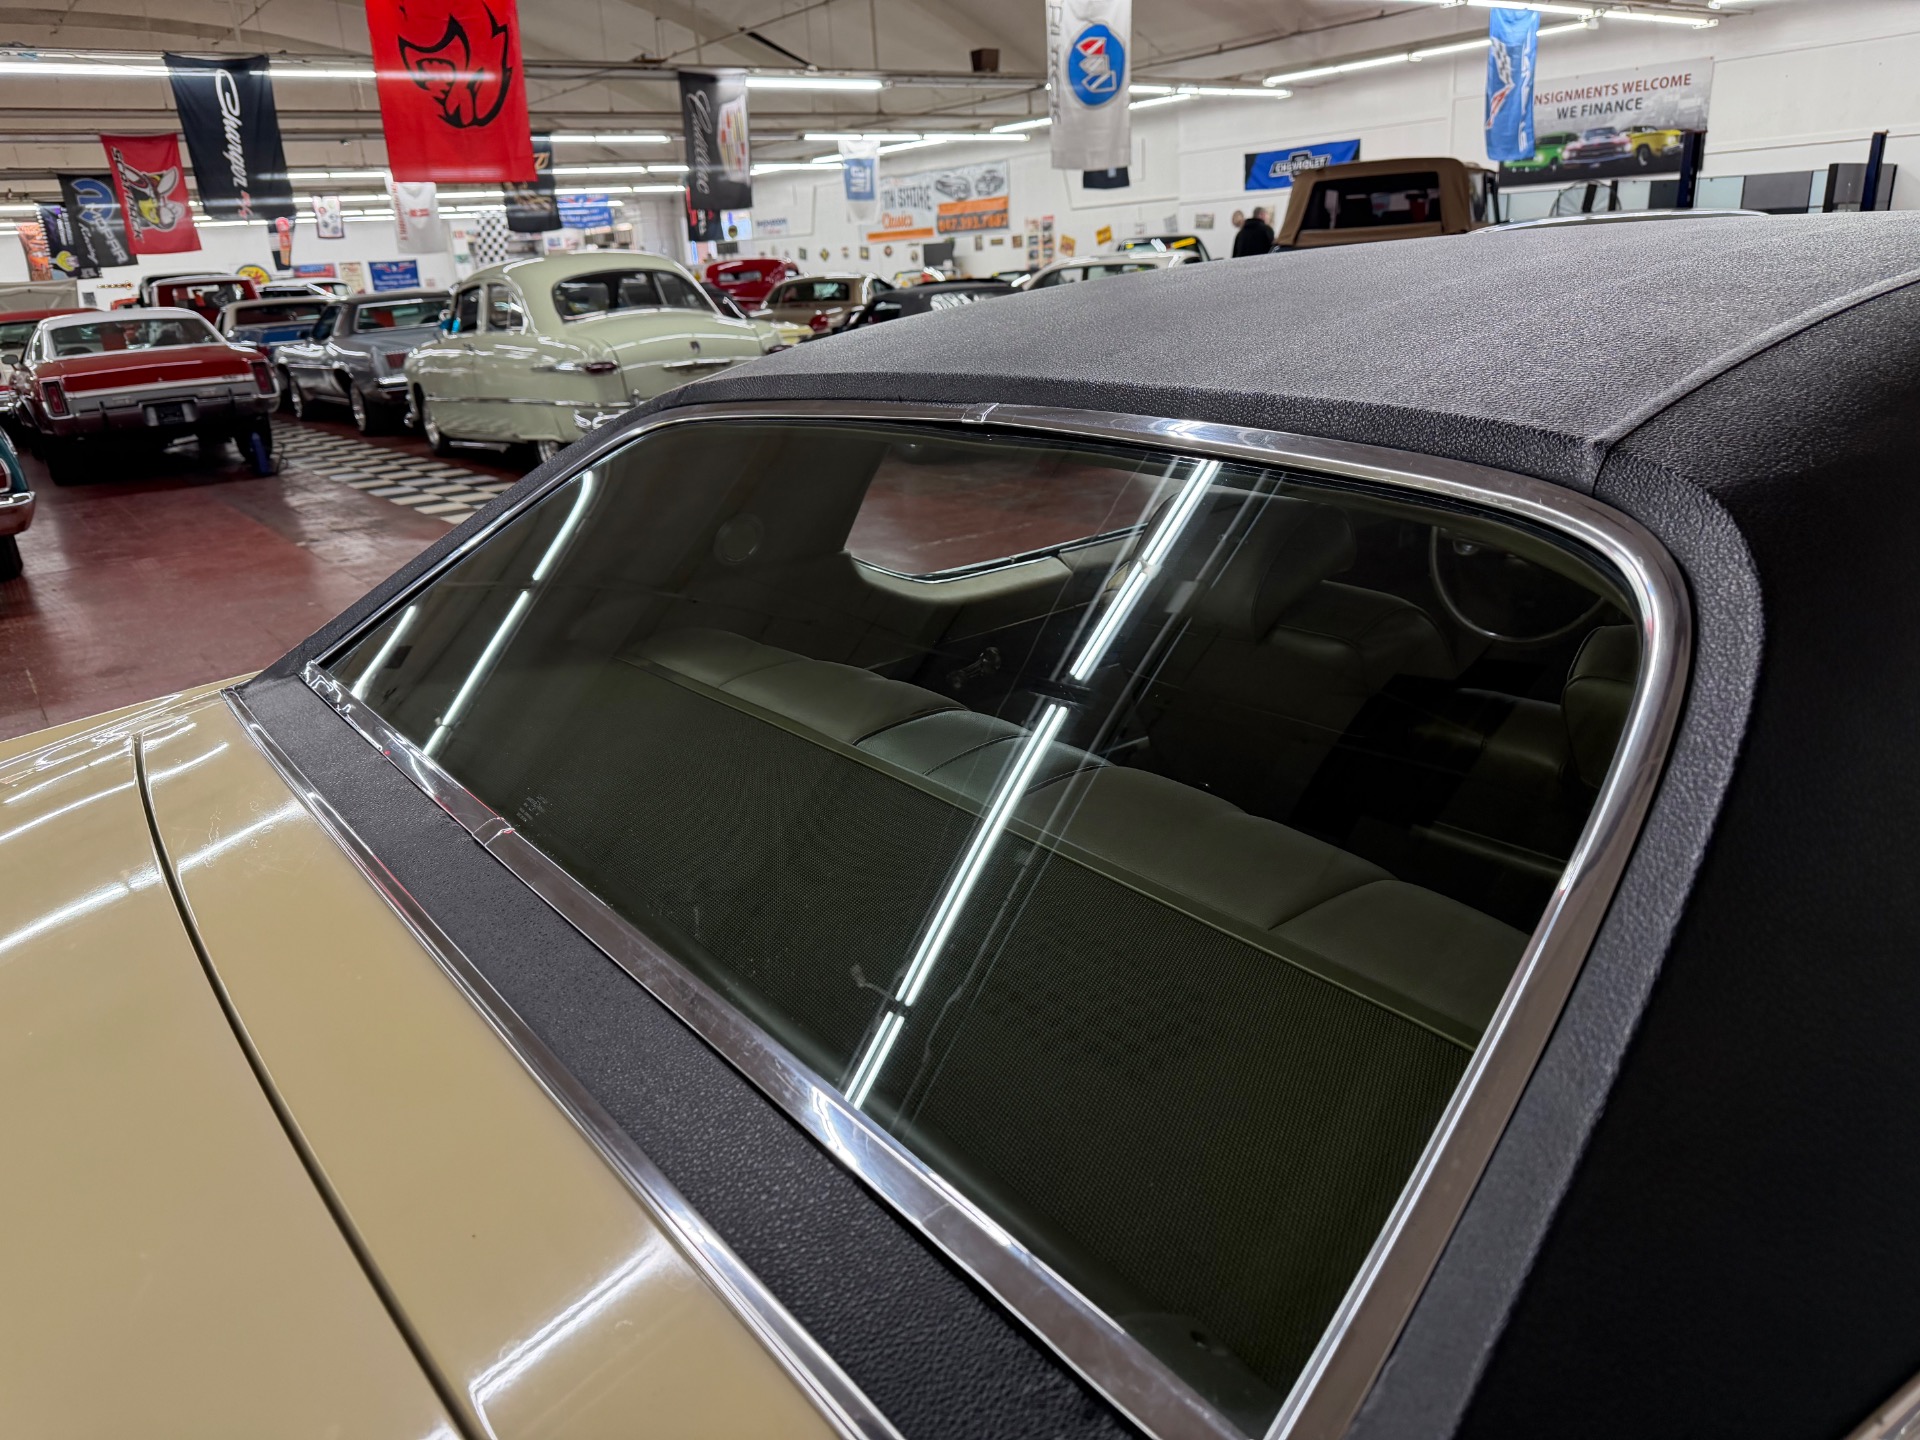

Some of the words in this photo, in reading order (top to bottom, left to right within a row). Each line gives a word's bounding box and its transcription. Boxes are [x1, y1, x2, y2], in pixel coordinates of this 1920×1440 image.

[1622, 73, 1692, 94] WELCOME
[215, 69, 249, 188] Charger
[1556, 105, 1577, 120] WE
[1580, 97, 1643, 118] FINANCE
[686, 90, 713, 195] Cadillac
[1274, 157, 1328, 173] CHEVROLET
[85, 202, 129, 265] MOPAR
